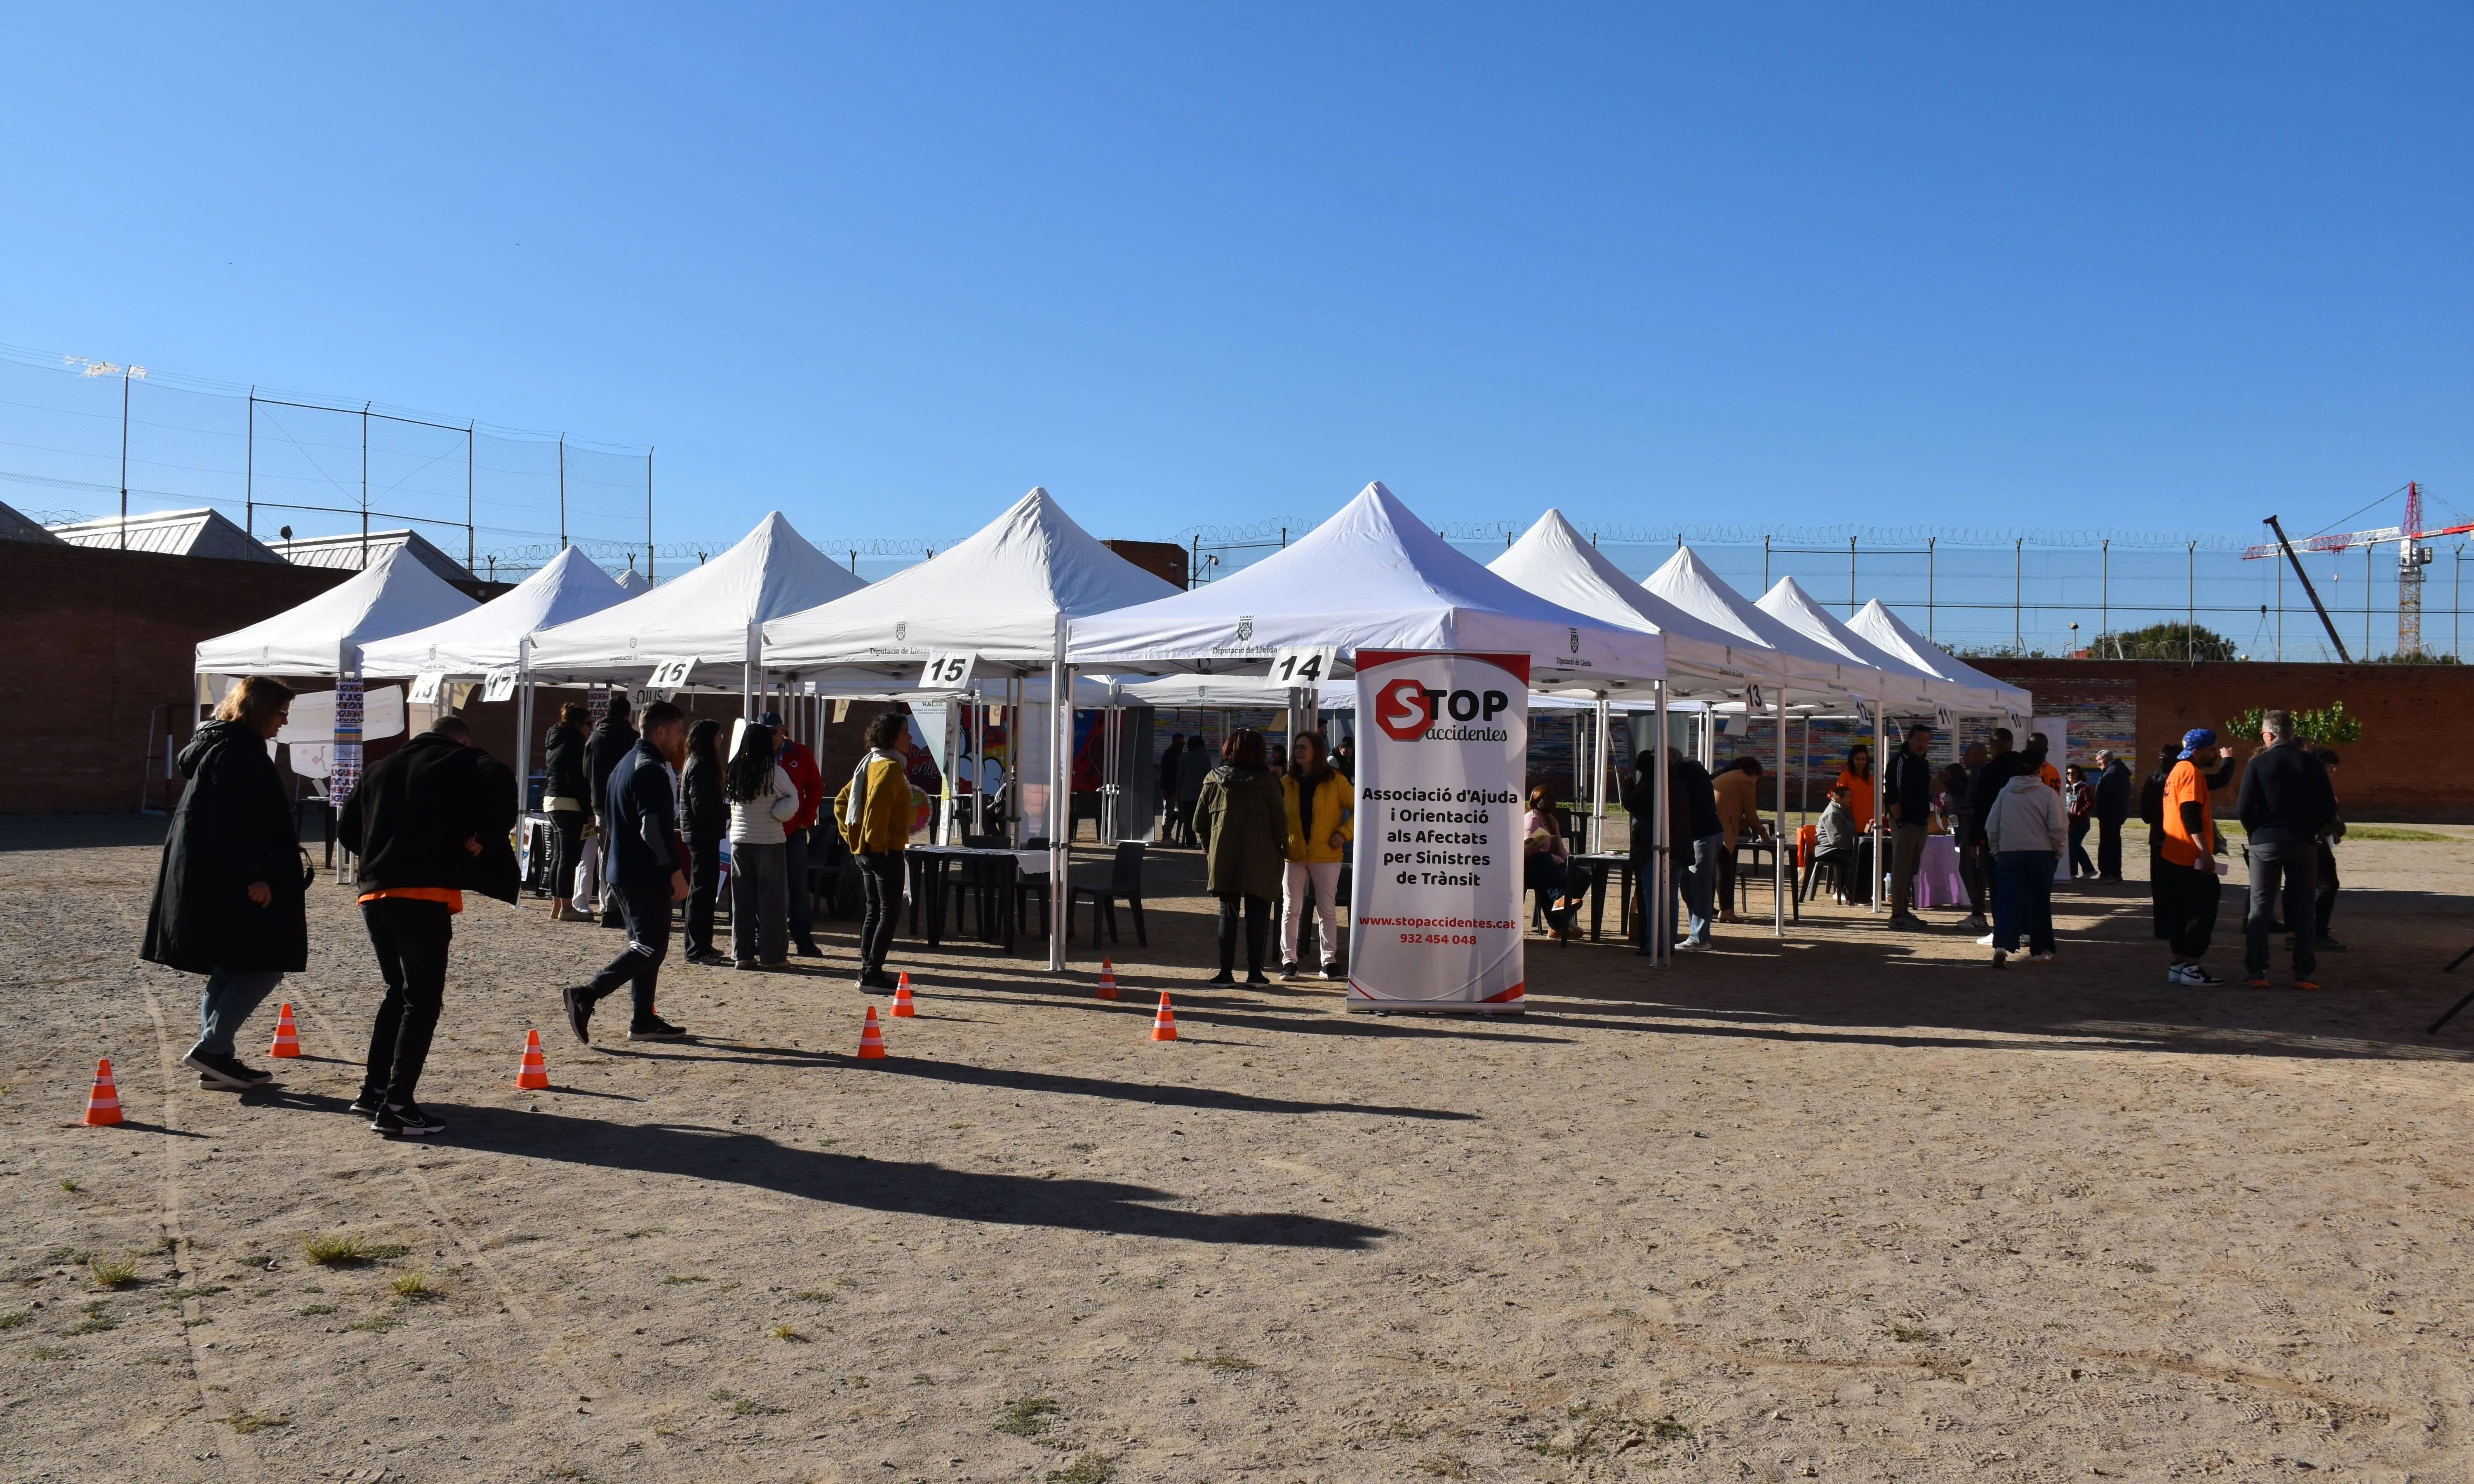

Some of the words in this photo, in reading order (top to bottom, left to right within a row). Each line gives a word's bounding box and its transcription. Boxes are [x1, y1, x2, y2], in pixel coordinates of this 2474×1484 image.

[658, 663, 686, 682] 16
[931, 658, 967, 682] 15
[1279, 655, 1323, 681] 14
[488, 676, 512, 696] 17
[1747, 683, 1762, 707] 13
[1385, 686, 1508, 729] STOP
[1856, 701, 1870, 721] 12
[1938, 707, 1951, 725] 11
[2011, 713, 2021, 728] 10
[1425, 725, 1508, 742] accidentes
[1362, 787, 1452, 802] Associació
[1456, 789, 1518, 805] d'Ajuda
[1391, 808, 1395, 821] i
[1399, 808, 1489, 824] Orientació
[1387, 829, 1411, 843] als
[1416, 830, 1488, 845] Afectats
[1384, 852, 1412, 866] per
[1416, 850, 1490, 866] Sinistres
[1396, 871, 1417, 884] de
[1421, 871, 1480, 886] Trànsit
[1359, 916, 1516, 929] www.stopaccidentes.cat
[1400, 933, 1422, 943] 932
[1425, 934, 1449, 944] 454
[1452, 935, 1477, 945] 048
